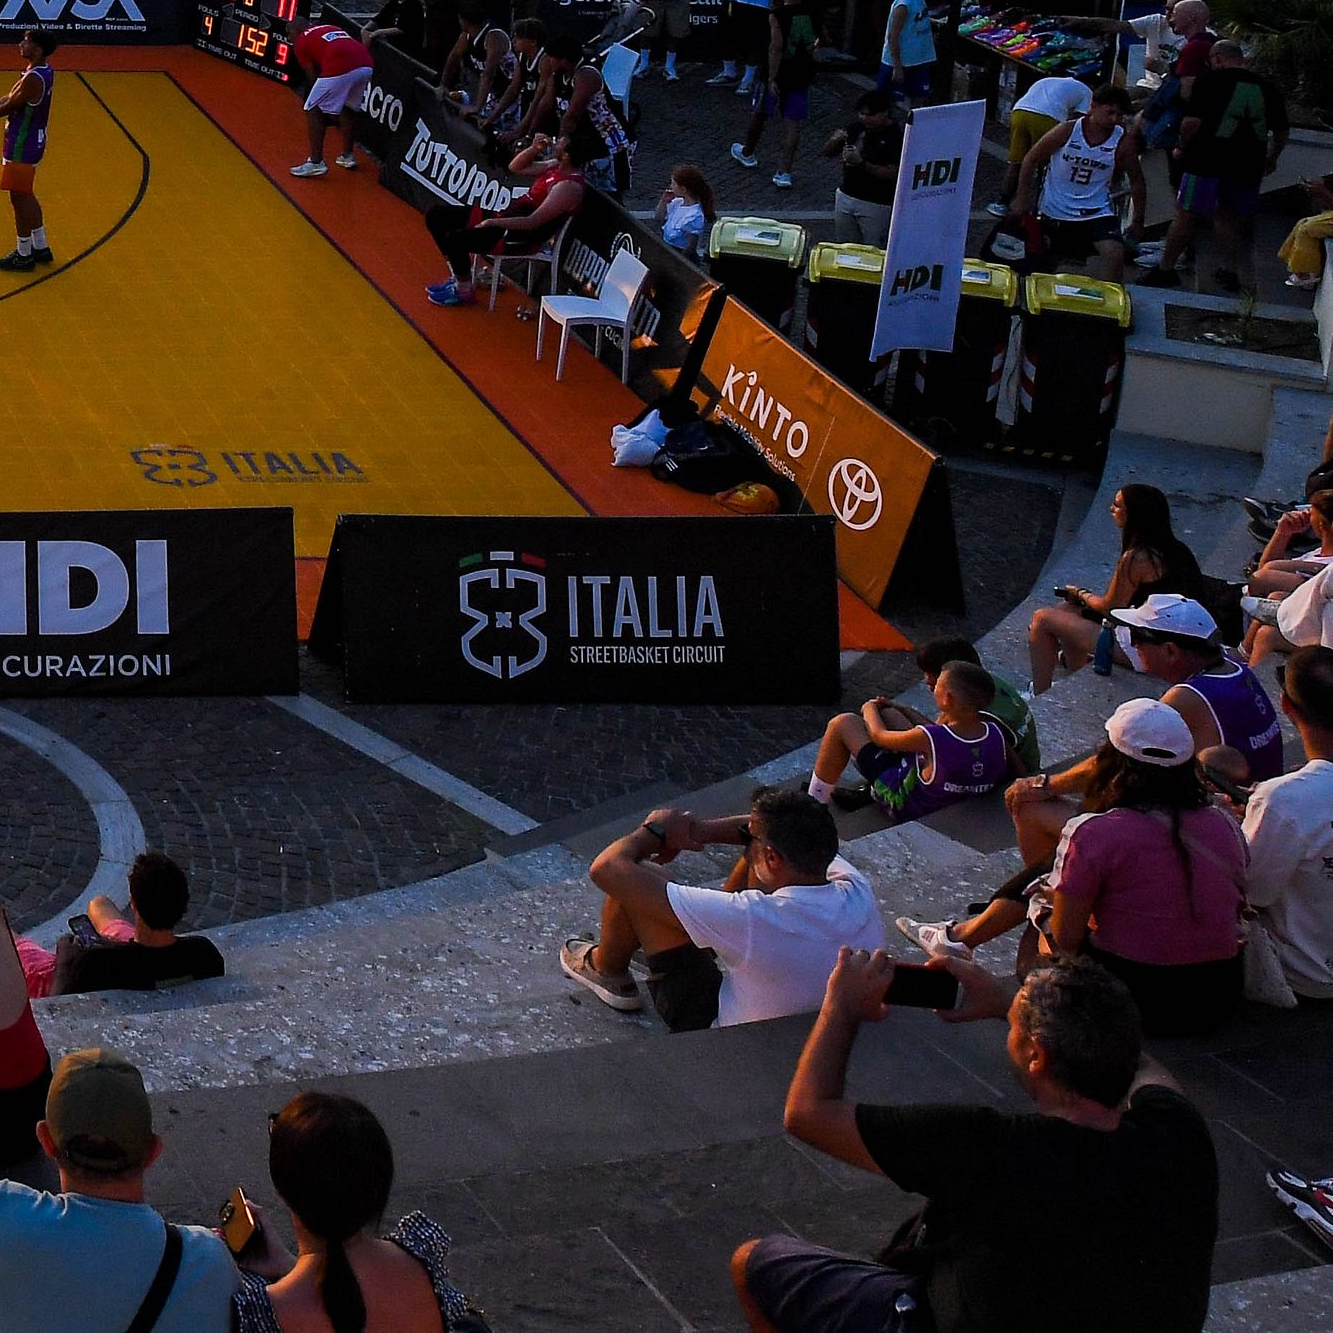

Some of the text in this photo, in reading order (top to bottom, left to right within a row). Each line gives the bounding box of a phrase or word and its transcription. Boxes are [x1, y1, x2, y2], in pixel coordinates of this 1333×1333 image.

[105, 23, 147, 32] Streaming
[204, 16, 213, 35] 4
[275, 43, 288, 65] 9
[911, 157, 961, 190] HDI
[889, 264, 944, 296] HDI
[221, 451, 365, 475] ITALIA
[763, 447, 796, 482] Solutions
[566, 575, 725, 638] ITALIA
[569, 644, 726, 665] STREETBASKET CIRCUIT
